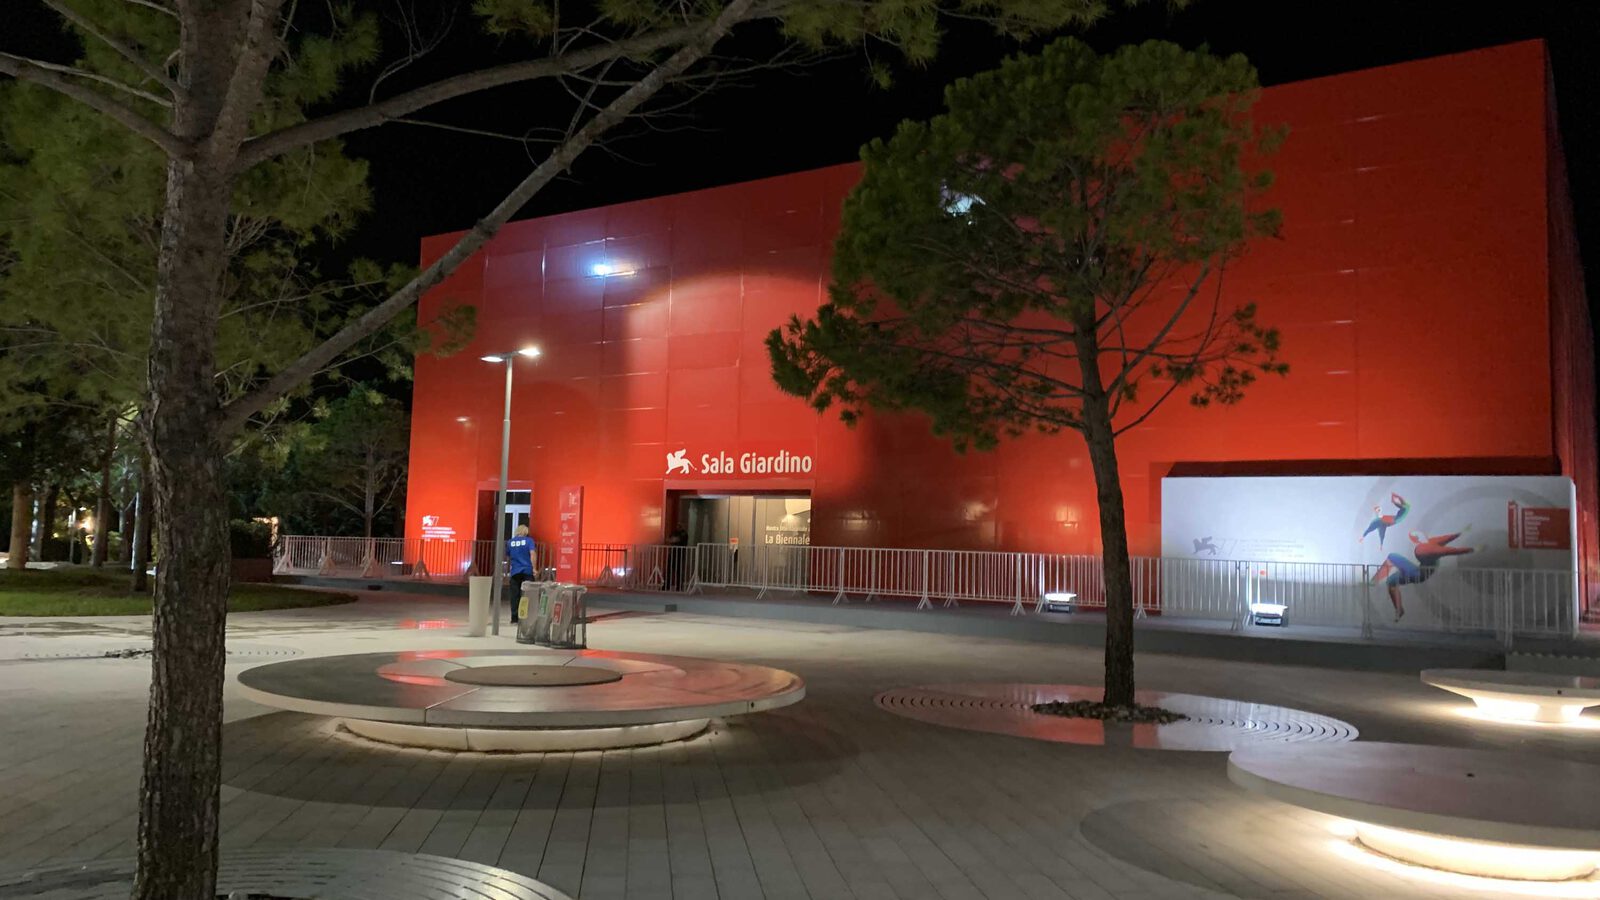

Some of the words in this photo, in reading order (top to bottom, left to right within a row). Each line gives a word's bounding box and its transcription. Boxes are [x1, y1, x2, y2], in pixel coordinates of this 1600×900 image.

[701, 450, 734, 474] Sala
[740, 449, 812, 474] Giardino
[765, 534, 774, 544] La
[775, 533, 811, 545] Biennale
